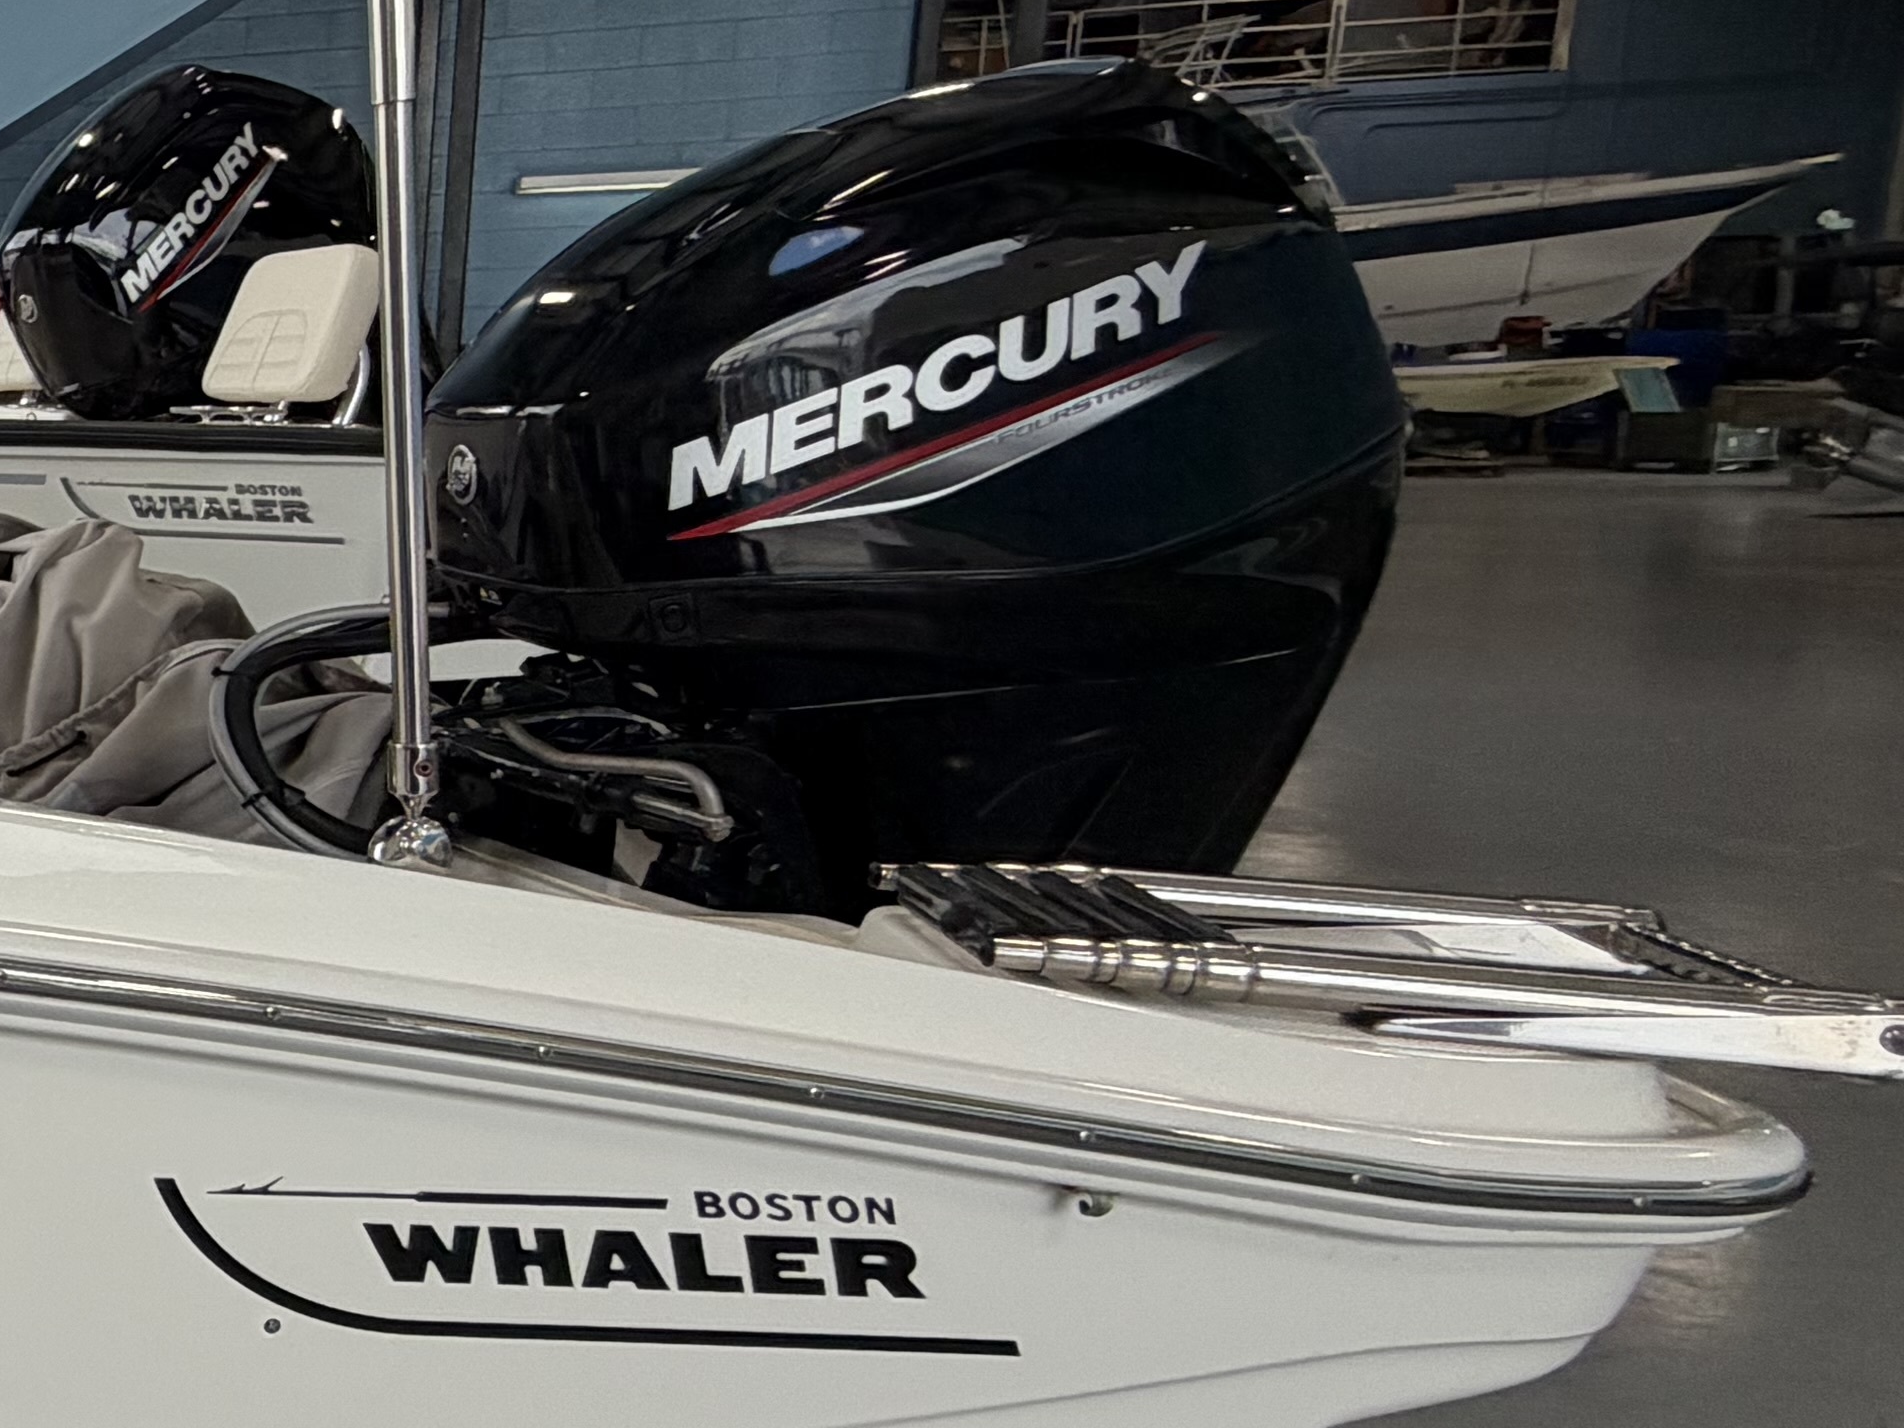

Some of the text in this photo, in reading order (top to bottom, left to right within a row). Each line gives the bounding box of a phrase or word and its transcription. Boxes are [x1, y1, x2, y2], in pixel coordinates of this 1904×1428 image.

[120, 121, 259, 304] MERCURY
[667, 239, 1207, 511] MERCURY
[127, 494, 314, 525] WHALER
[234, 483, 304, 497] BOSTON
[693, 1190, 897, 1226] BOSTON
[362, 1222, 928, 1299] WHALER
